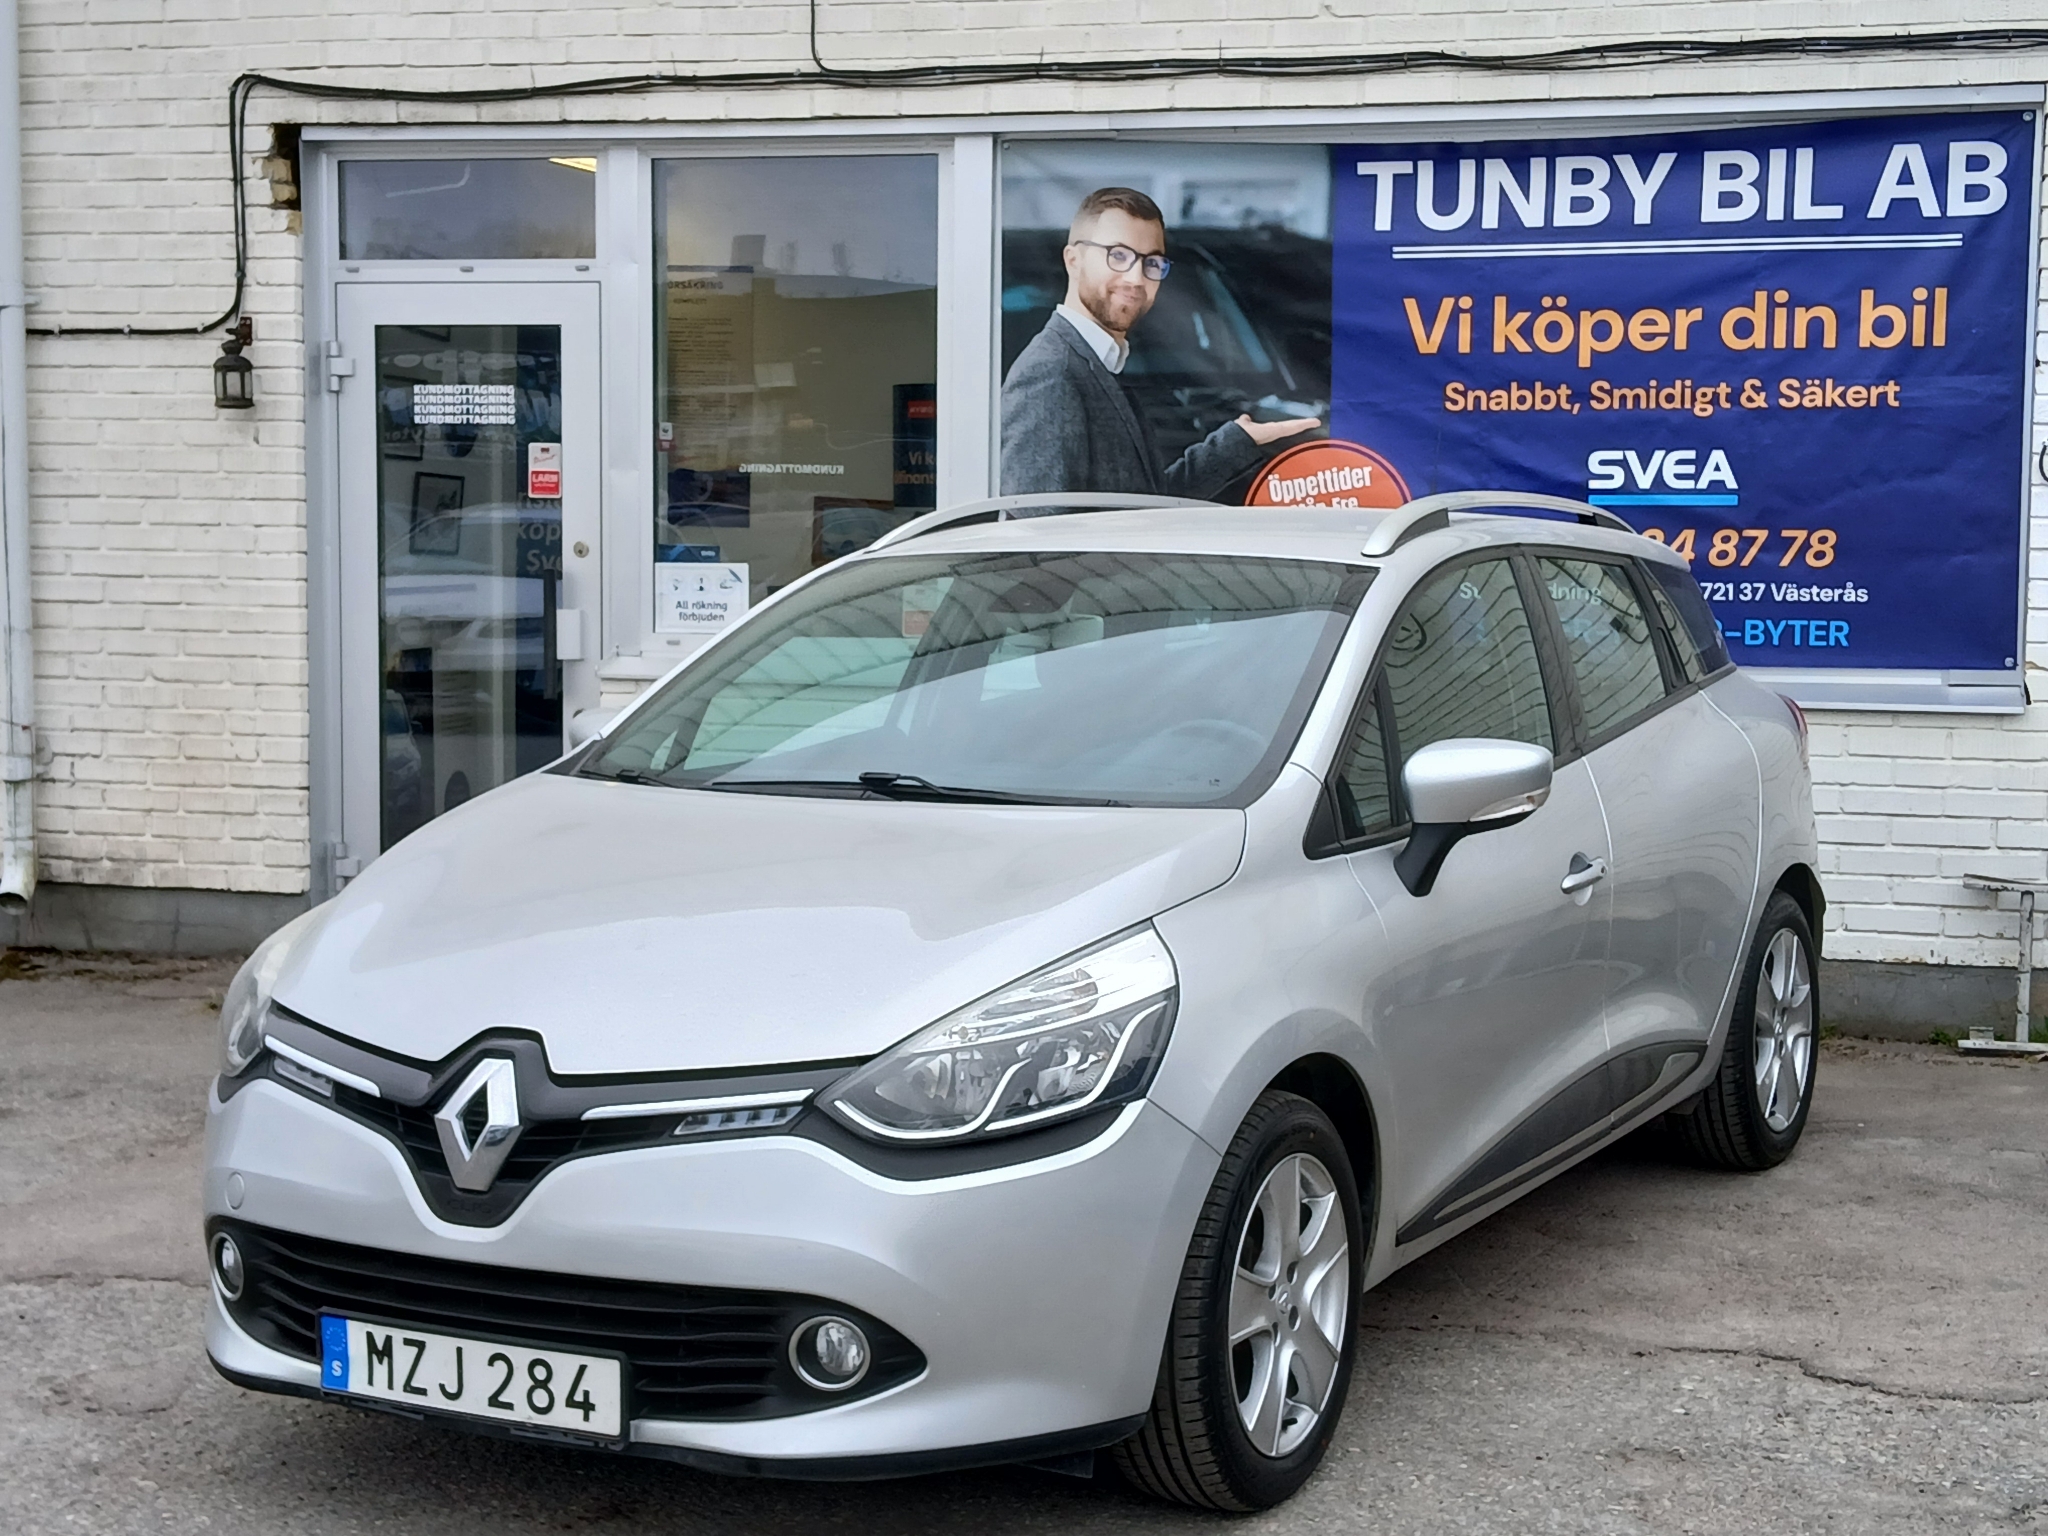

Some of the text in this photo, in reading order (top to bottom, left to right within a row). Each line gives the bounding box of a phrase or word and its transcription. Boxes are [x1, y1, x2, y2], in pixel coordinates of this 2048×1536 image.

[1357, 140, 2008, 231] TUNBY BIL AB
[1404, 287, 1949, 368] Vi köper din bil
[413, 384, 516, 395] KUNDMOTTAGNING
[413, 394, 516, 404] KUNDMOTTAGNING
[1444, 378, 1900, 416] Snabbt, Smidigt & Säkert
[413, 405, 516, 414] KUNDMOTTAGNING
[413, 415, 516, 425] KUNDMOTTAGNING
[1588, 449, 1738, 490] SVEA
[1268, 466, 1372, 503] Öppettider
[1708, 529, 1769, 567] 87
[1779, 529, 1838, 568] 78
[1700, 582, 1868, 602] 721 37 Västerås
[676, 601, 728, 612] All rökning
[679, 612, 725, 623] förbjuden
[1715, 618, 1849, 647] -BYTER
[331, 1360, 343, 1377] S
[366, 1331, 596, 1422] MZJ 284
